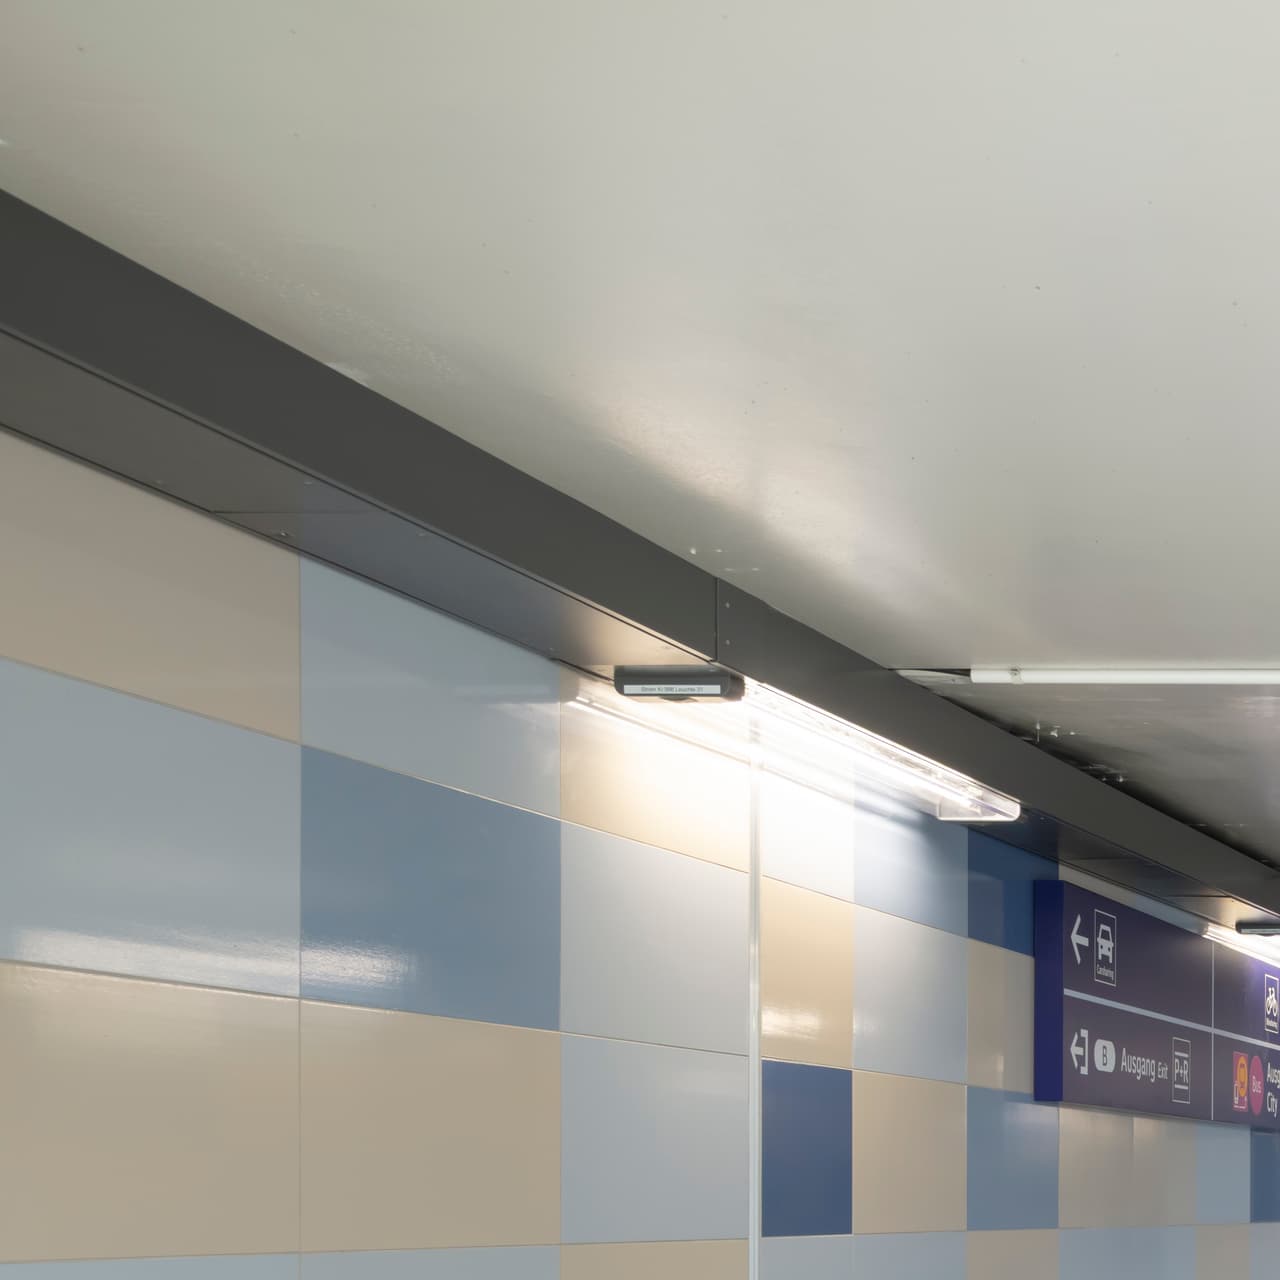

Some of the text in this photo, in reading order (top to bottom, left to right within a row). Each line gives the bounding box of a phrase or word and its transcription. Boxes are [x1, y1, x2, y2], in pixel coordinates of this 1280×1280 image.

[1102, 1045, 1189, 1083] B Ausgang Exit P+R
[1252, 1075, 1262, 1093] Bus
[1266, 1091, 1278, 1118] City
